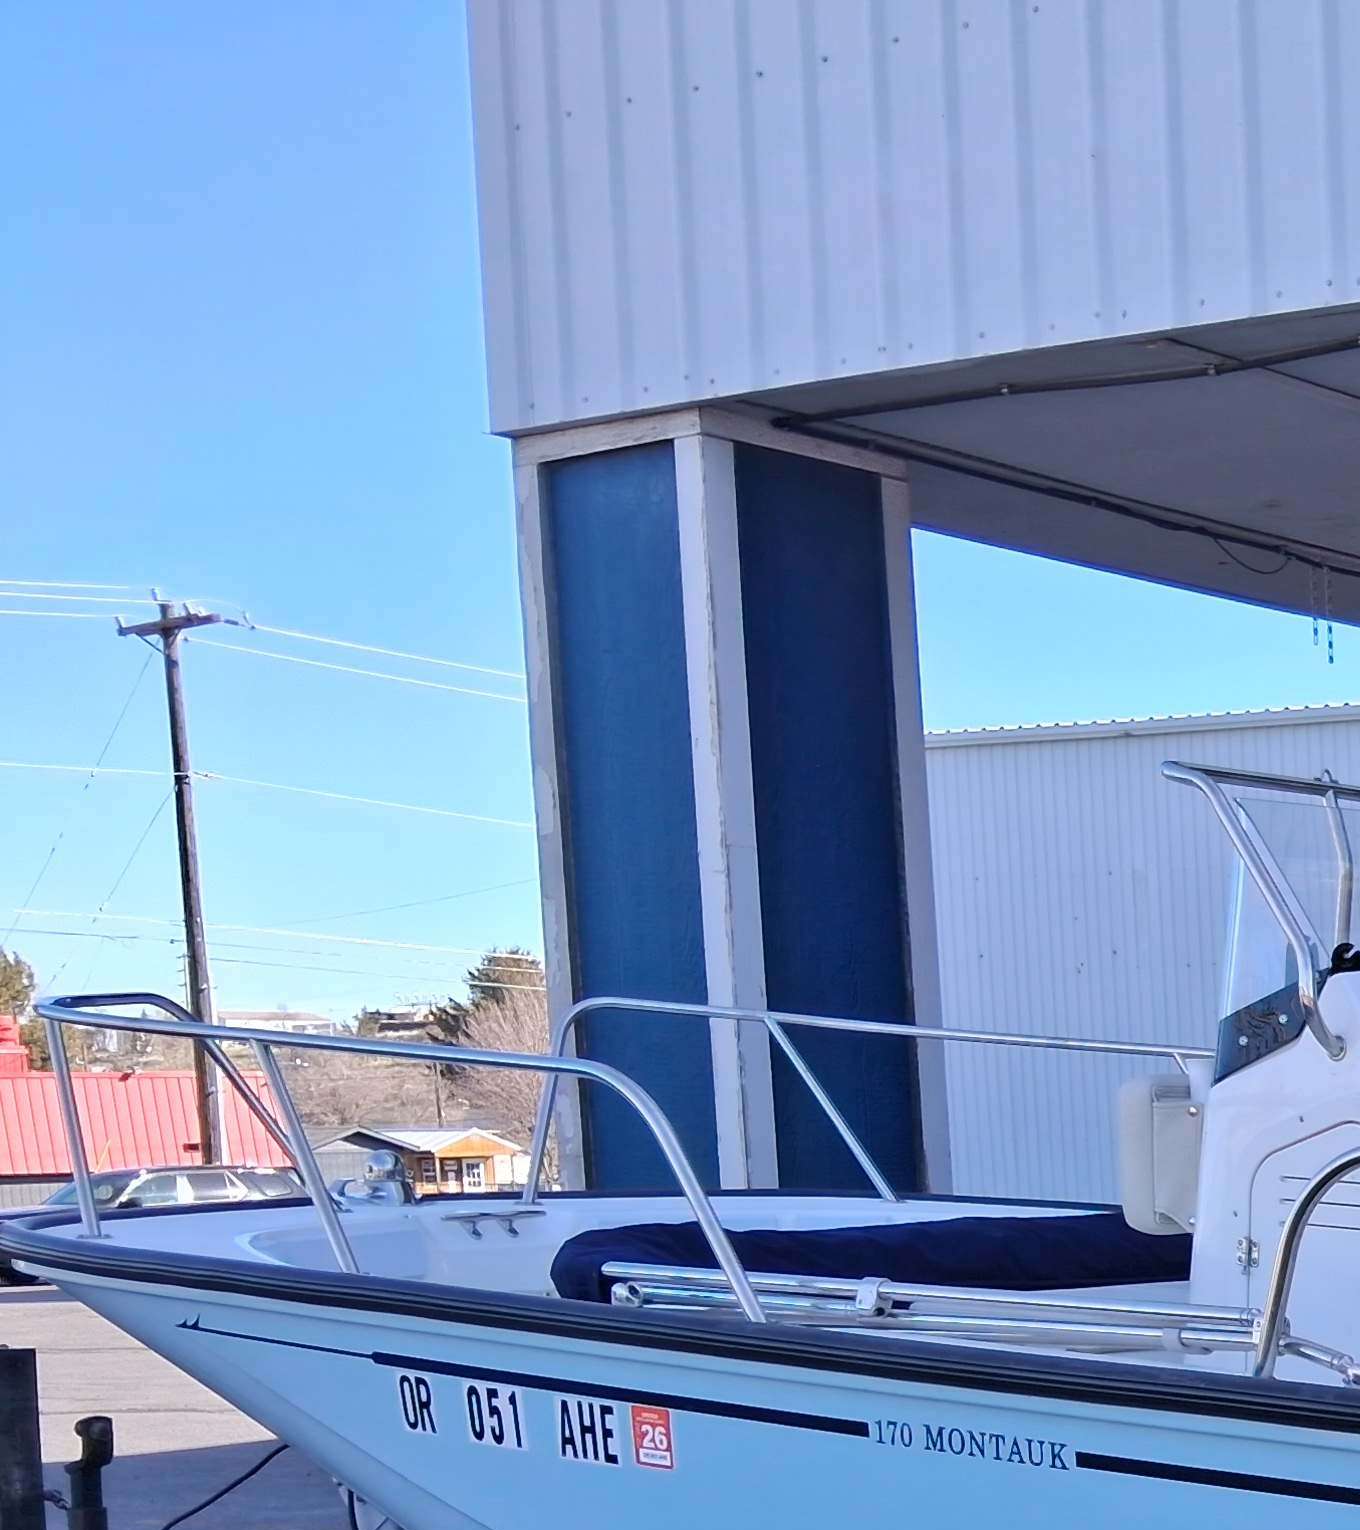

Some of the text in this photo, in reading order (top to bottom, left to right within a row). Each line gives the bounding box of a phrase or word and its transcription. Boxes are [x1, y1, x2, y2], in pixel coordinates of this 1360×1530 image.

[399, 1374, 620, 1466] OR 051 AHE
[640, 1424, 668, 1451] 26
[874, 1419, 1070, 1471] 170 MONTAUK
